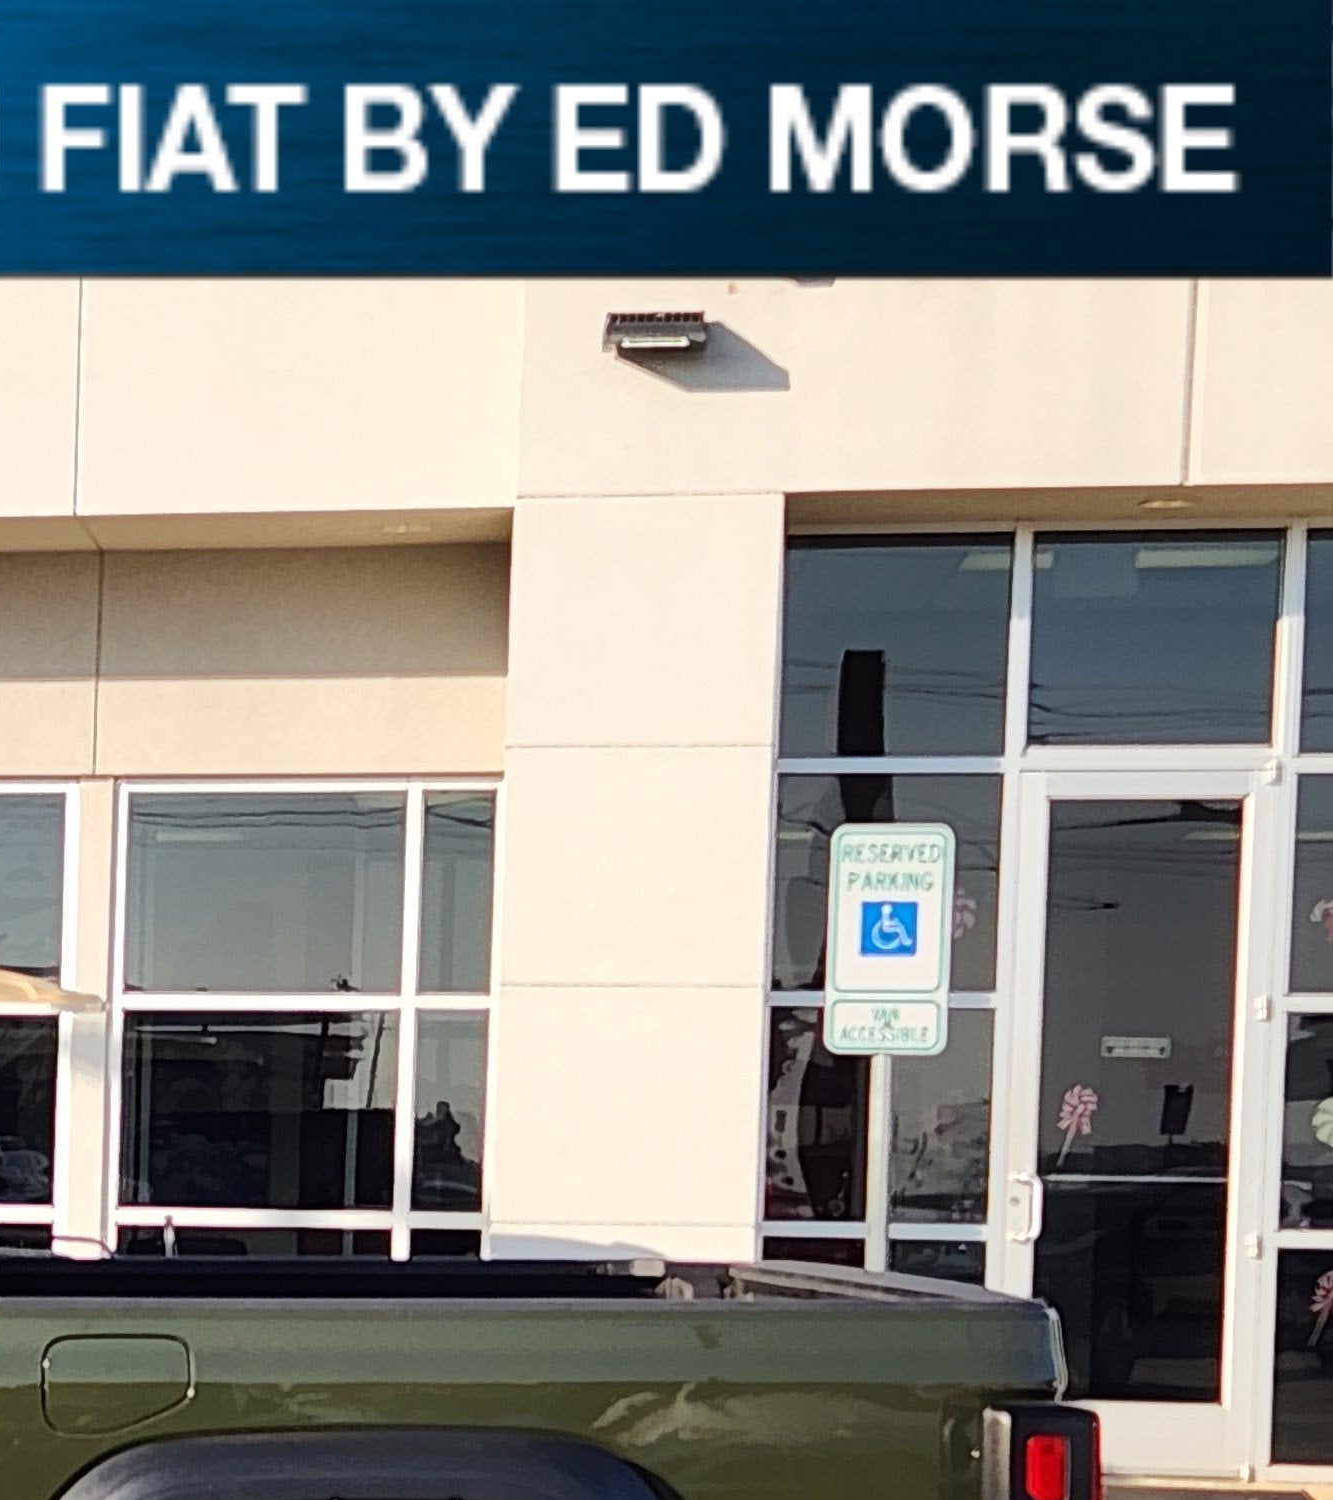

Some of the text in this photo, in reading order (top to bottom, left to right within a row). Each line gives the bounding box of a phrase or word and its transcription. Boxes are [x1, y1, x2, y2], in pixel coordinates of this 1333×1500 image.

[841, 843, 942, 864] RESERVED
[846, 871, 934, 892] PARKING
[871, 1007, 900, 1021] VAN
